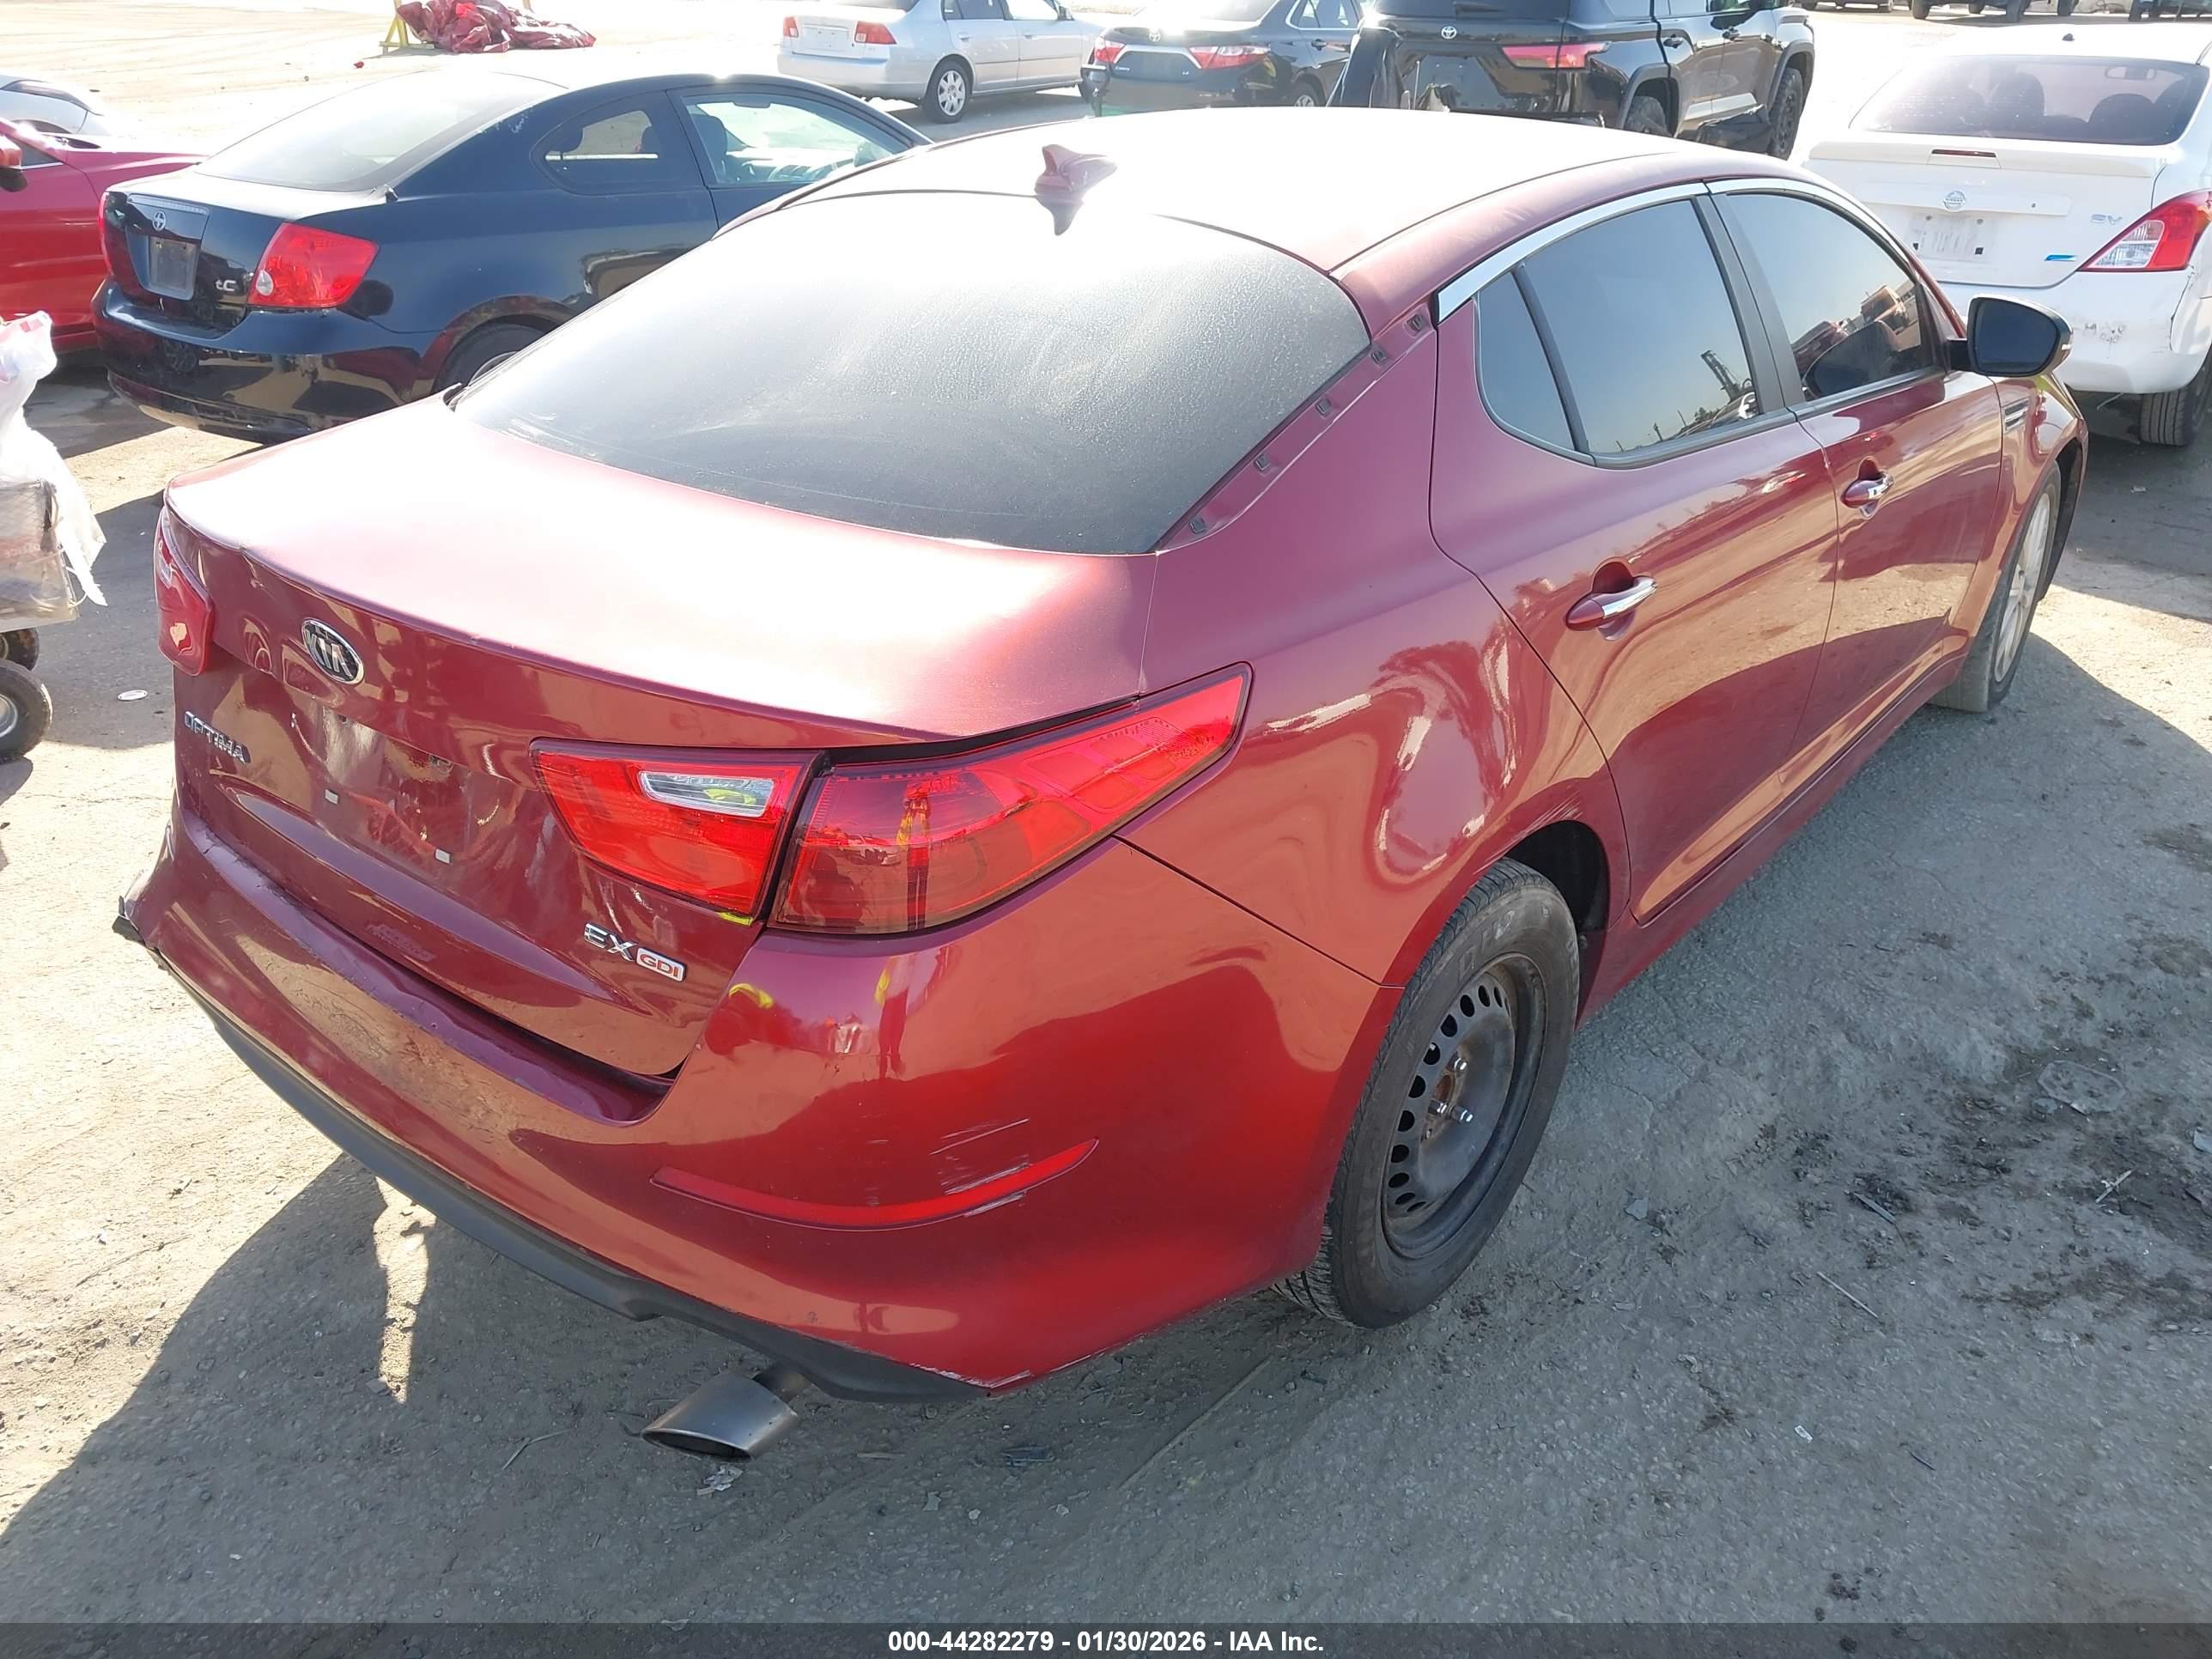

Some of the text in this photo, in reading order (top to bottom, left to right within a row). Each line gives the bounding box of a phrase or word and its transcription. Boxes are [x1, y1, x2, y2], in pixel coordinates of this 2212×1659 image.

[305, 629, 355, 680] KIA
[584, 921, 681, 978] EX GDI
